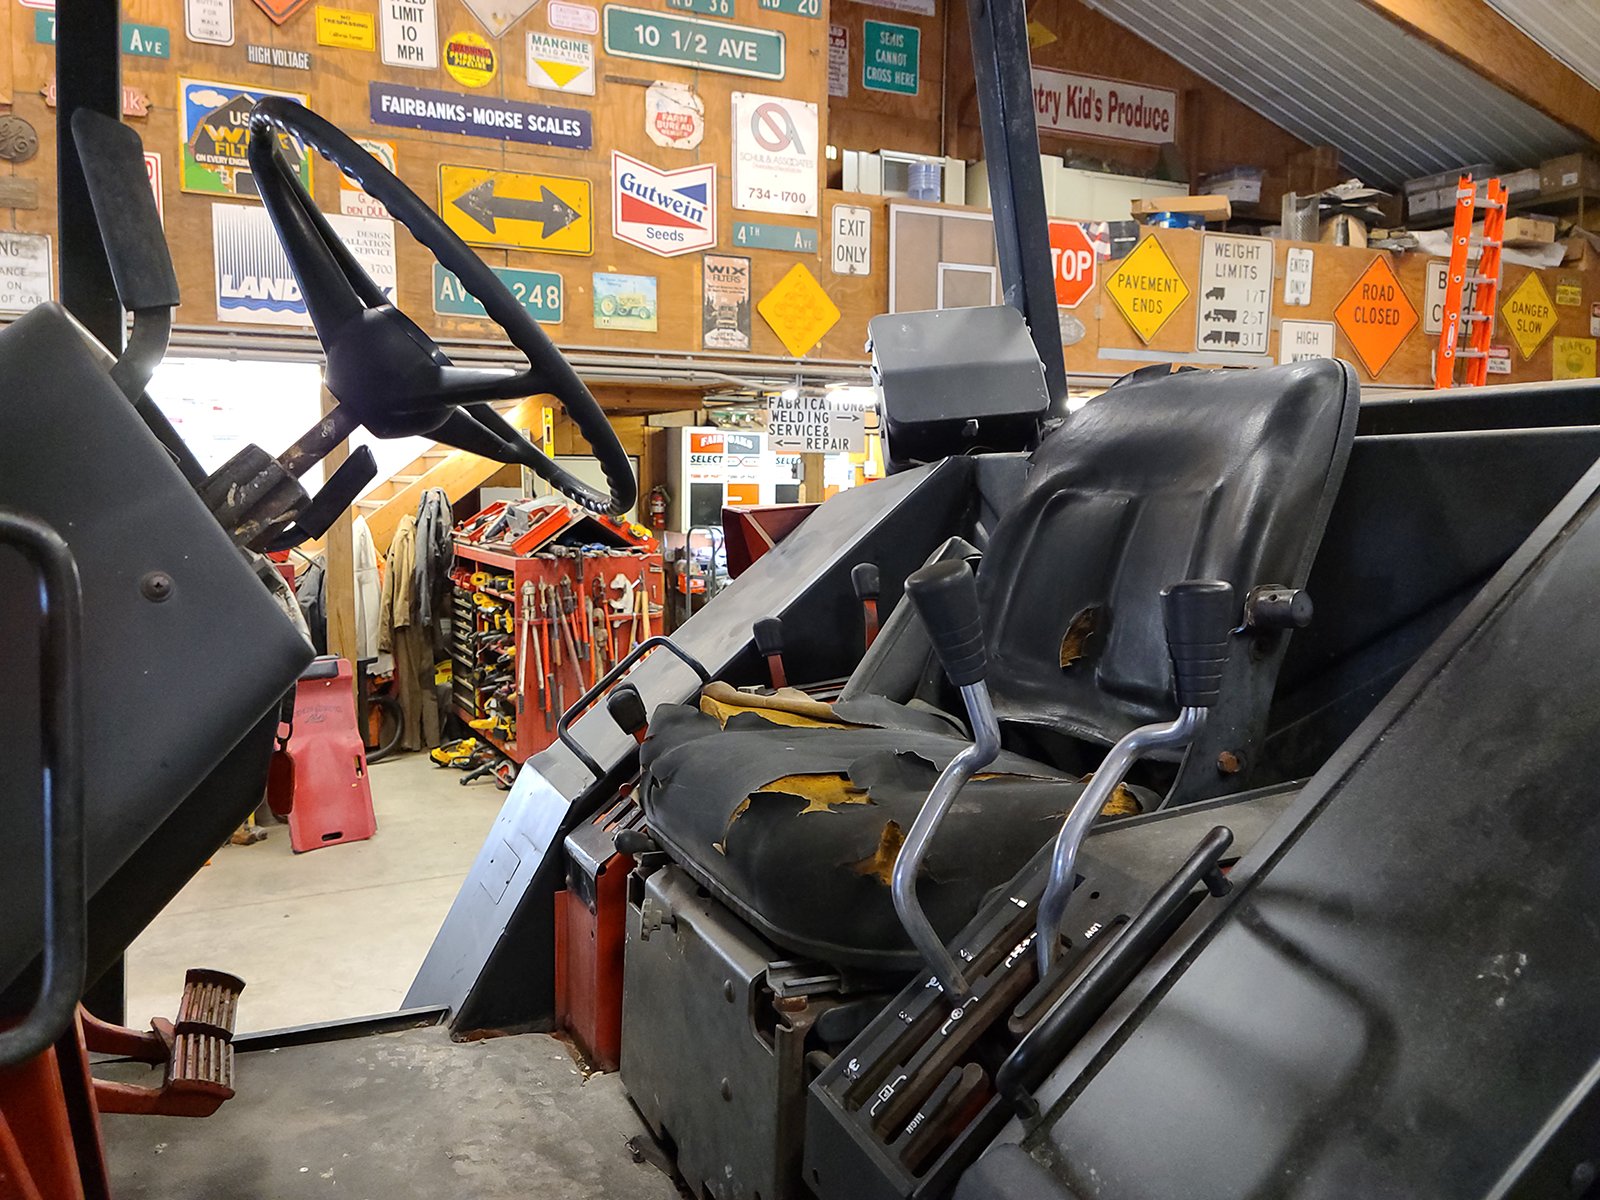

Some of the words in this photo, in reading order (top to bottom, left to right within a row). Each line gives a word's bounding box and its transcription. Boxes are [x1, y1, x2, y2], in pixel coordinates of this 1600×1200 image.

[392, 5, 424, 22] LIMIT
[710, 0, 728, 13] 36
[798, 0, 818, 15] 20
[402, 25, 417, 41] 10
[130, 29, 162, 54] AVE
[532, 35, 588, 53] MANGINE
[634, 24, 660, 46] 10
[672, 31, 708, 54] 1/2
[718, 38, 758, 62] AVE
[248, 46, 270, 64] HIGH
[272, 49, 310, 70] VOLTAGE
[398, 44, 424, 61] MPH
[531, 46, 590, 60] IRRIGATION
[876, 49, 907, 67] CANNOT
[867, 66, 892, 83] CROSS
[895, 71, 915, 87] HERE
[381, 94, 523, 129] FAIRBANKS-MORSE
[528, 115, 581, 137] SCALES
[1067, 85, 1102, 122] Kid's
[1108, 90, 1169, 132] Produce
[229, 110, 250, 126] US
[662, 112, 688, 123] FARM
[656, 120, 693, 132] BUREAU
[207, 155, 227, 164] EVERY
[228, 157, 250, 167] ENGIN
[620, 172, 703, 223] Gutwein
[357, 230, 391, 240] DESIGN
[646, 227, 684, 242] Seeds
[738, 226, 759, 244] 4TH
[839, 218, 865, 237] EXIT
[344, 238, 391, 248] ALLATION
[354, 246, 392, 257] SERVICE
[837, 244, 867, 263] ONLY
[1215, 243, 1261, 260] WEIGHT
[707, 265, 746, 276] WIX
[1051, 248, 1092, 282] TOP
[1215, 263, 1257, 280] LIMITS
[1290, 258, 1309, 273] ENTER
[7, 282, 22, 290] ON
[713, 274, 741, 283] FILTERS
[1118, 273, 1179, 293] PAVEMENT
[440, 276, 481, 304] AV
[513, 282, 560, 310] 248
[1290, 280, 1306, 295] ONLY
[1362, 284, 1394, 301] ROAD
[3, 294, 14, 302] OF
[20, 295, 42, 304] CAR
[1133, 298, 1163, 314] ENDS
[1354, 306, 1400, 325] CLOSED
[1512, 301, 1549, 318] DANGER
[1516, 319, 1542, 333] SLOW
[1242, 333, 1263, 346] 31T
[1296, 331, 1319, 345] HIGH
[772, 411, 829, 423] WELDING
[768, 424, 829, 437] SERVICE&
[700, 435, 724, 447] FAIR
[806, 438, 849, 450] REPAIR
[690, 455, 723, 463] SELECT
[1085, 923, 1102, 939] LOW
